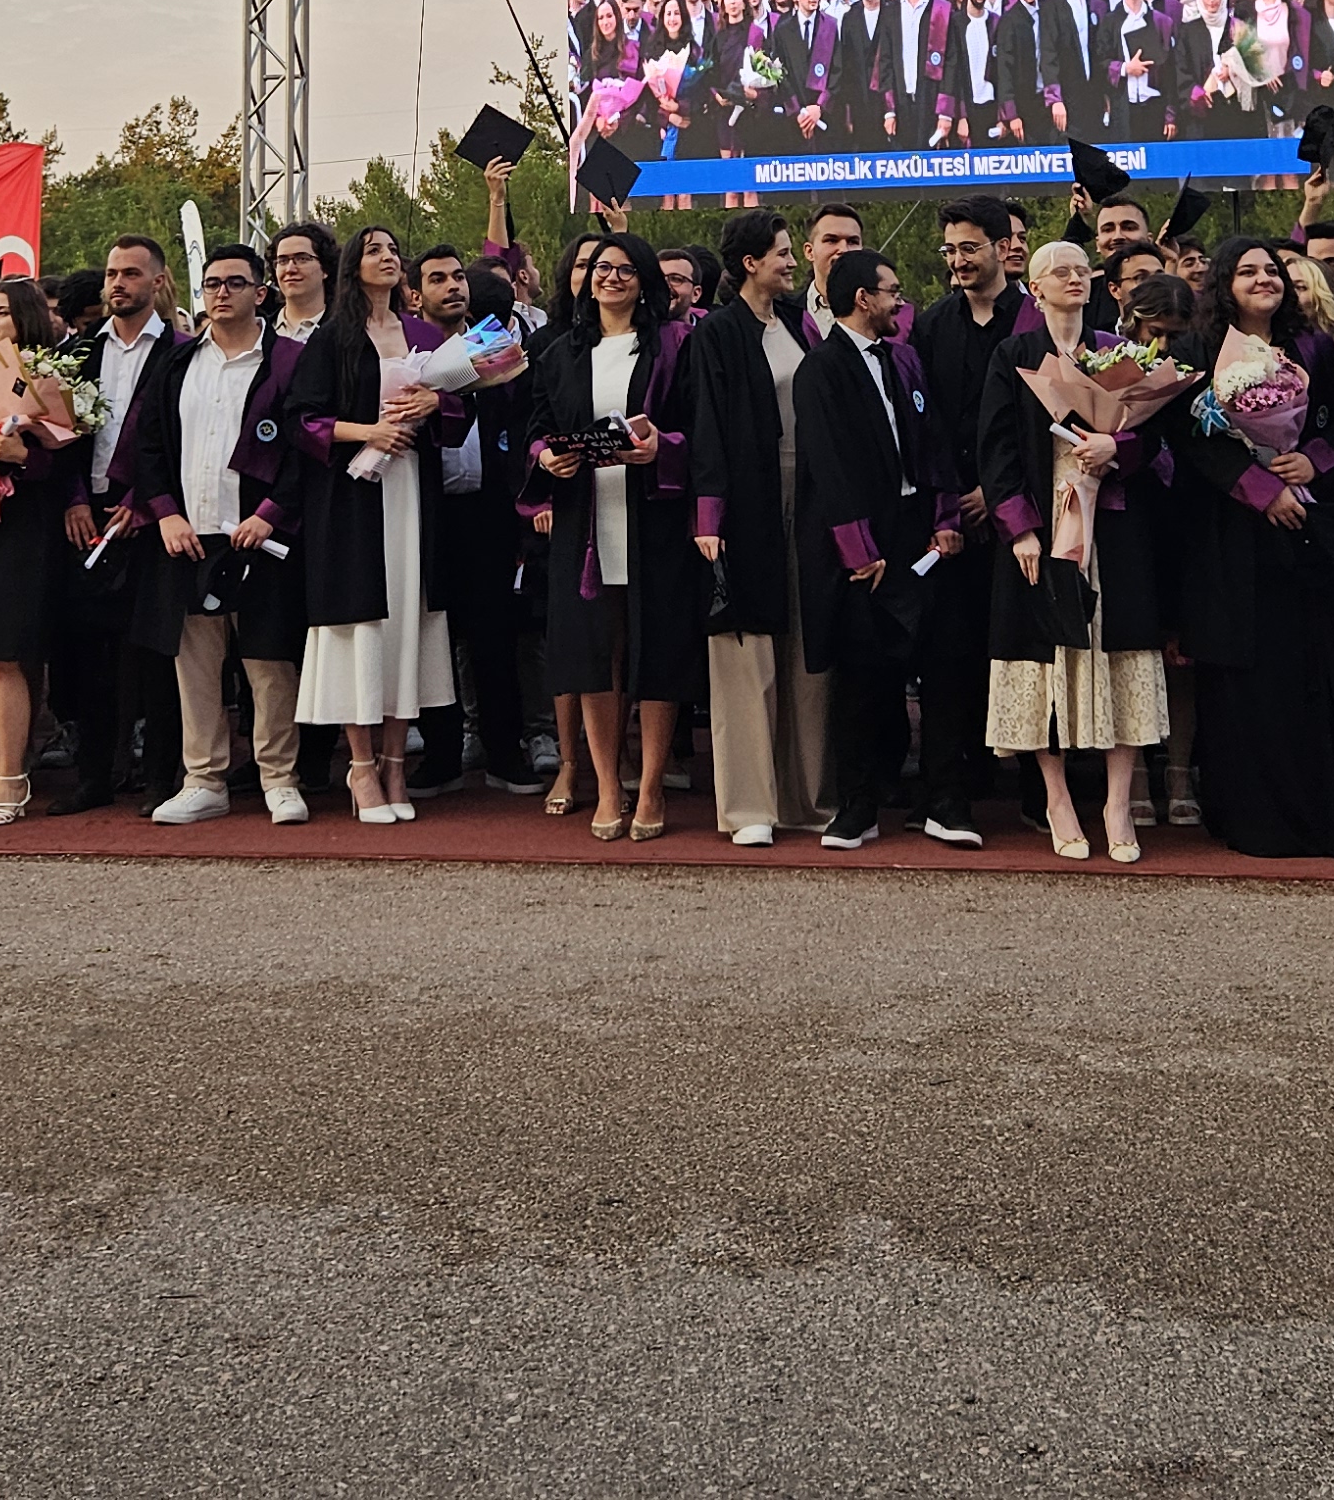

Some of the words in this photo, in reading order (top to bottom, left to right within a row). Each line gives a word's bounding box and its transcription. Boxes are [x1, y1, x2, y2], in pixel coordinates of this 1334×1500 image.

[755, 156, 873, 184] MÜHENDİSLİK
[876, 152, 970, 180] FAKÜLTESİ
[973, 150, 1073, 176] MEZUNİYET
[572, 431, 609, 442] PAIN
